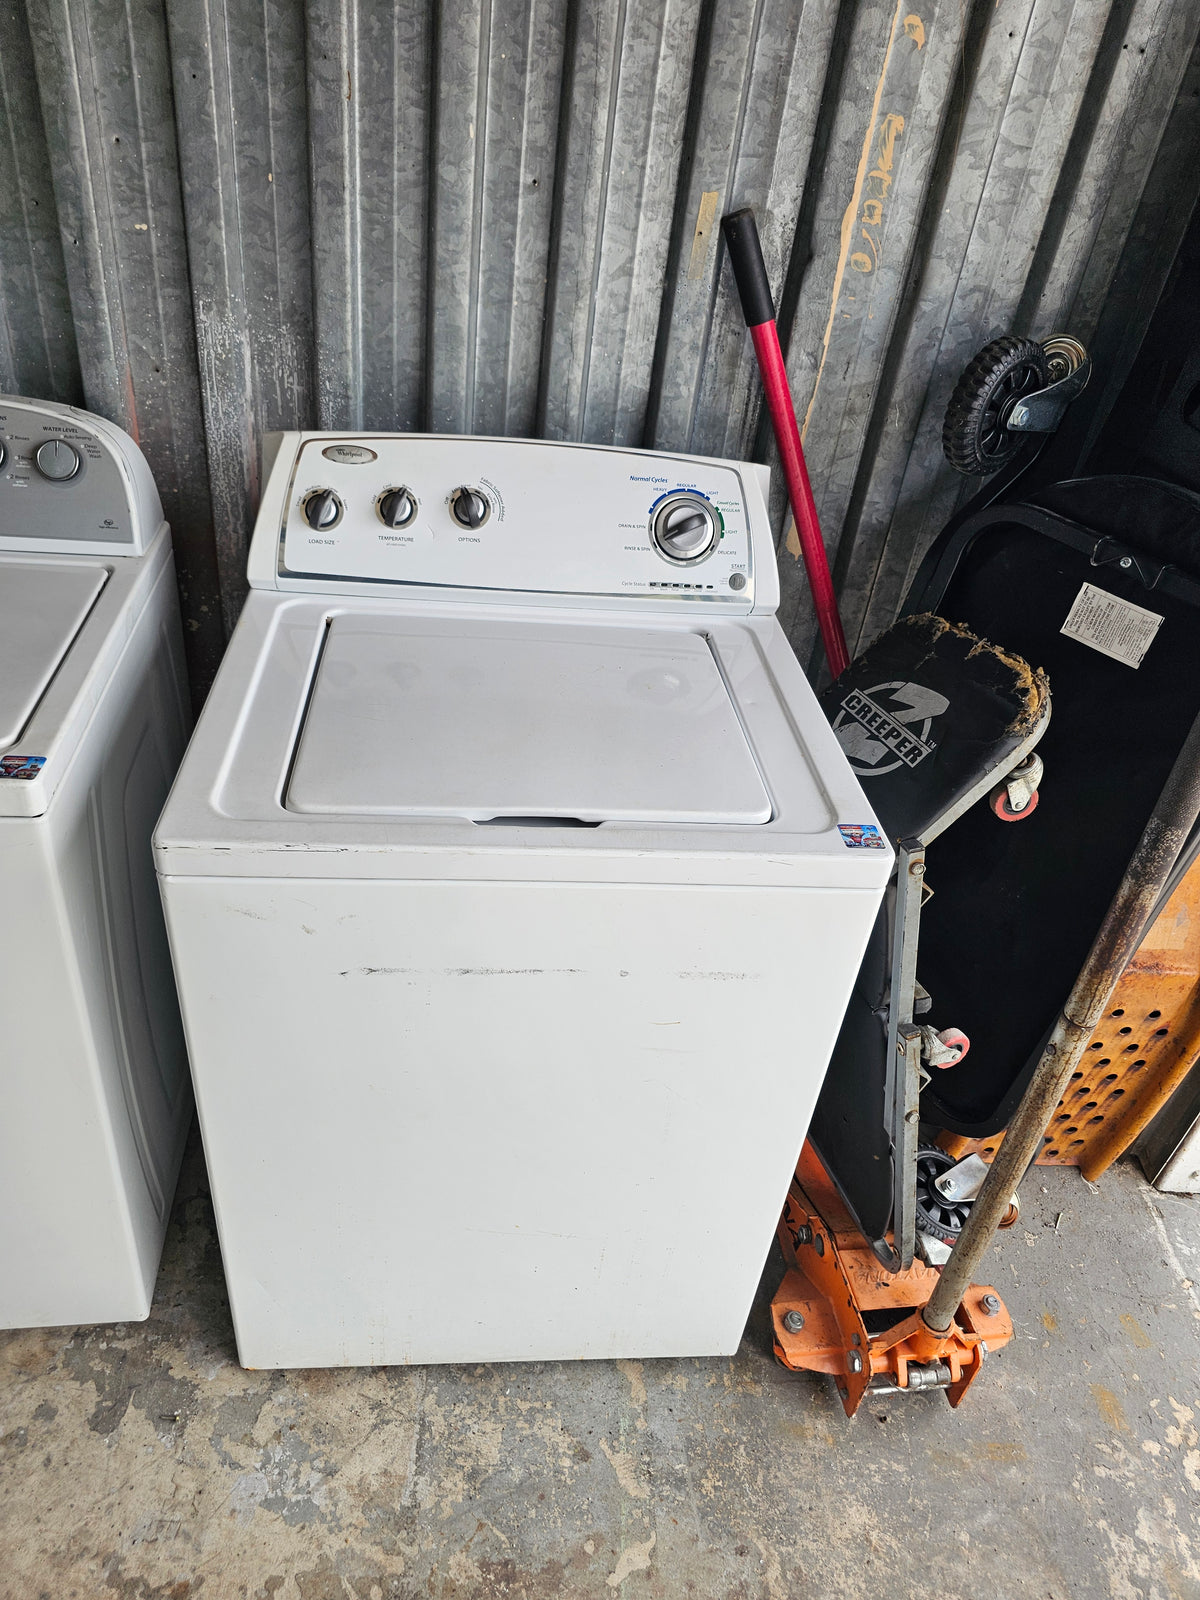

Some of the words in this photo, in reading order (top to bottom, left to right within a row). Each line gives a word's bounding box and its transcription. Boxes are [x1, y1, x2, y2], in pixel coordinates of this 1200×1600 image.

[336, 448, 363, 458] Whirlpool
[629, 475, 651, 483] Normal
[651, 476, 668, 484] Cycles
[844, 693, 924, 766] CREEPER
